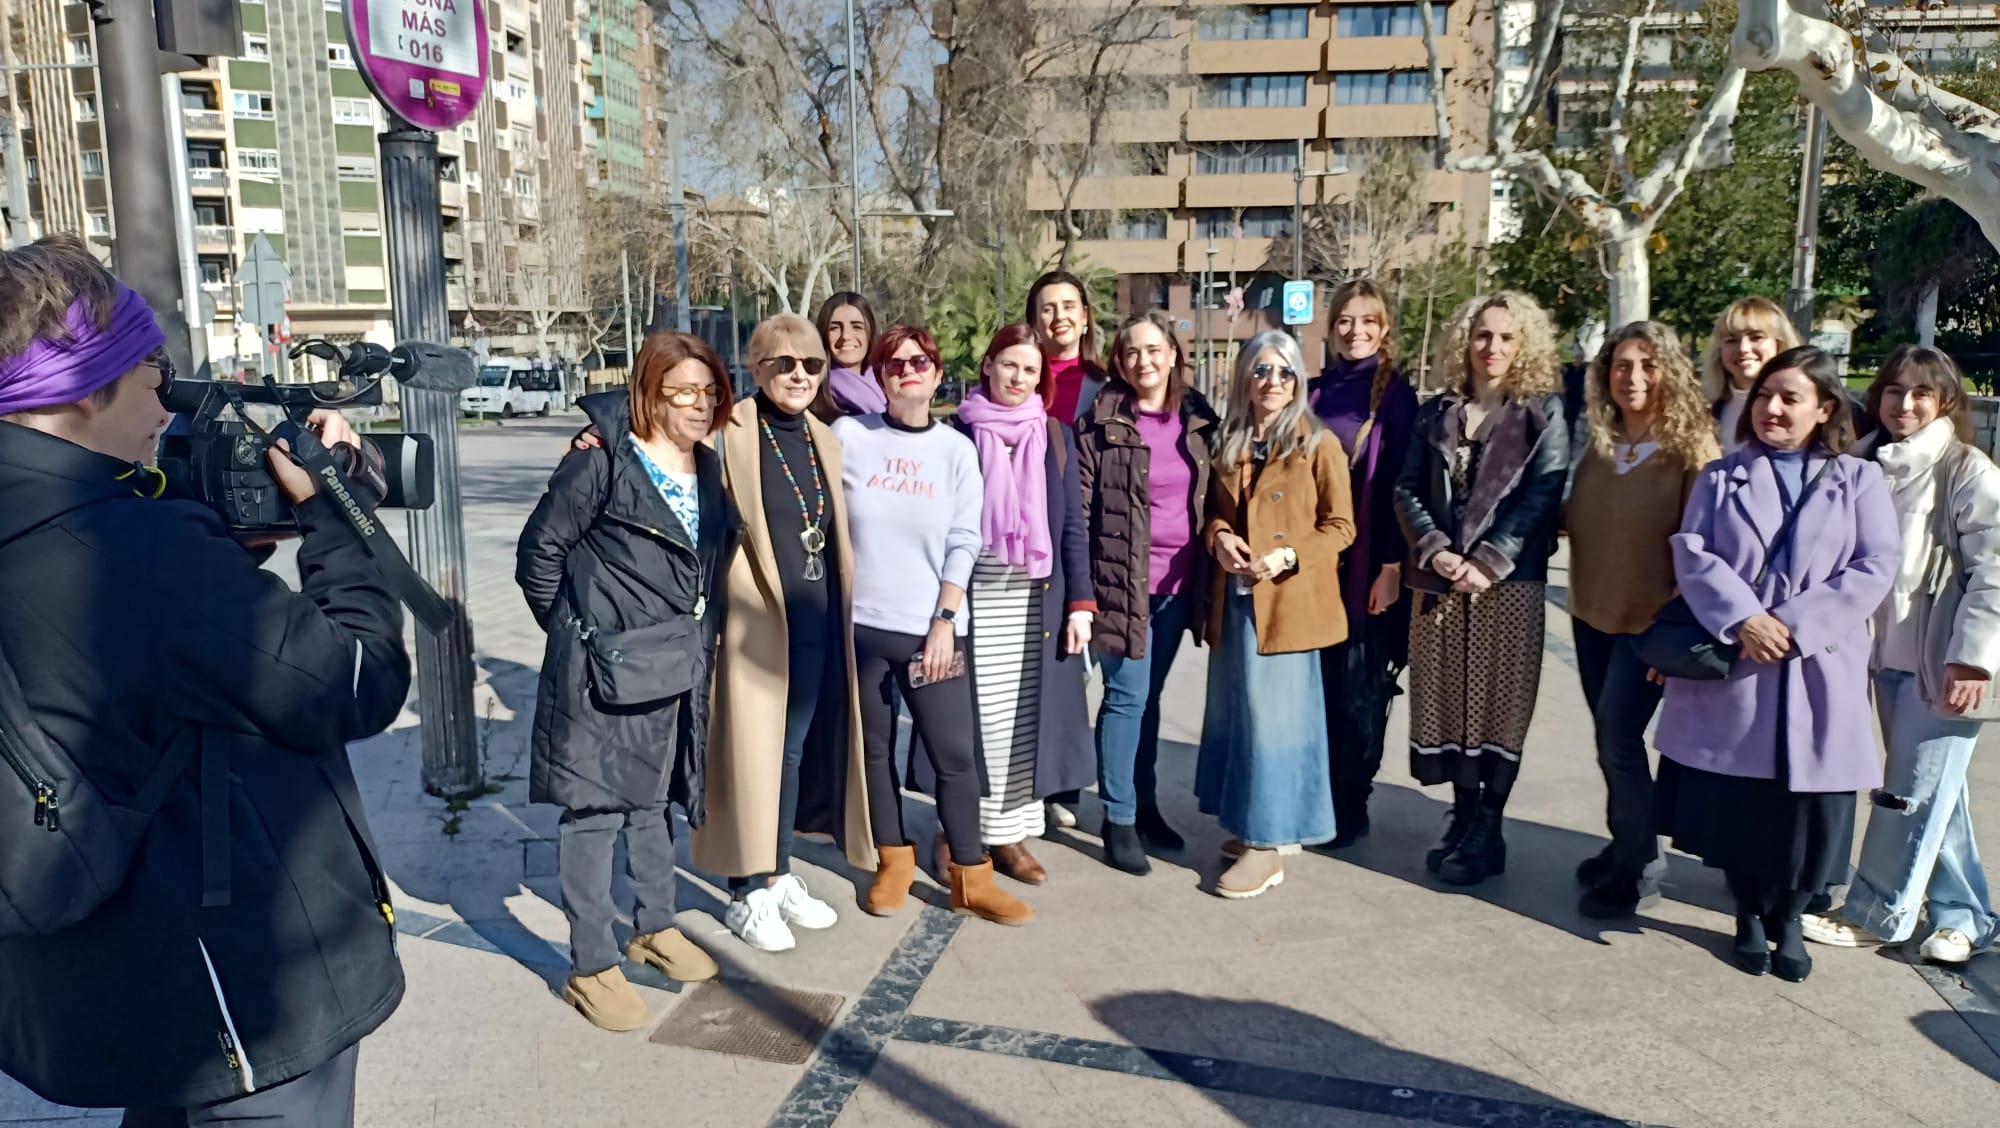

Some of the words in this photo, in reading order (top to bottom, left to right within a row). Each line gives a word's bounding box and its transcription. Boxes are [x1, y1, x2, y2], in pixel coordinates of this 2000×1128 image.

[402, 9, 446, 38] MÁS
[409, 39, 443, 63] 016
[883, 457, 924, 477] TRY
[866, 474, 934, 498] AGAIN
[320, 465, 376, 536] Panasonic
